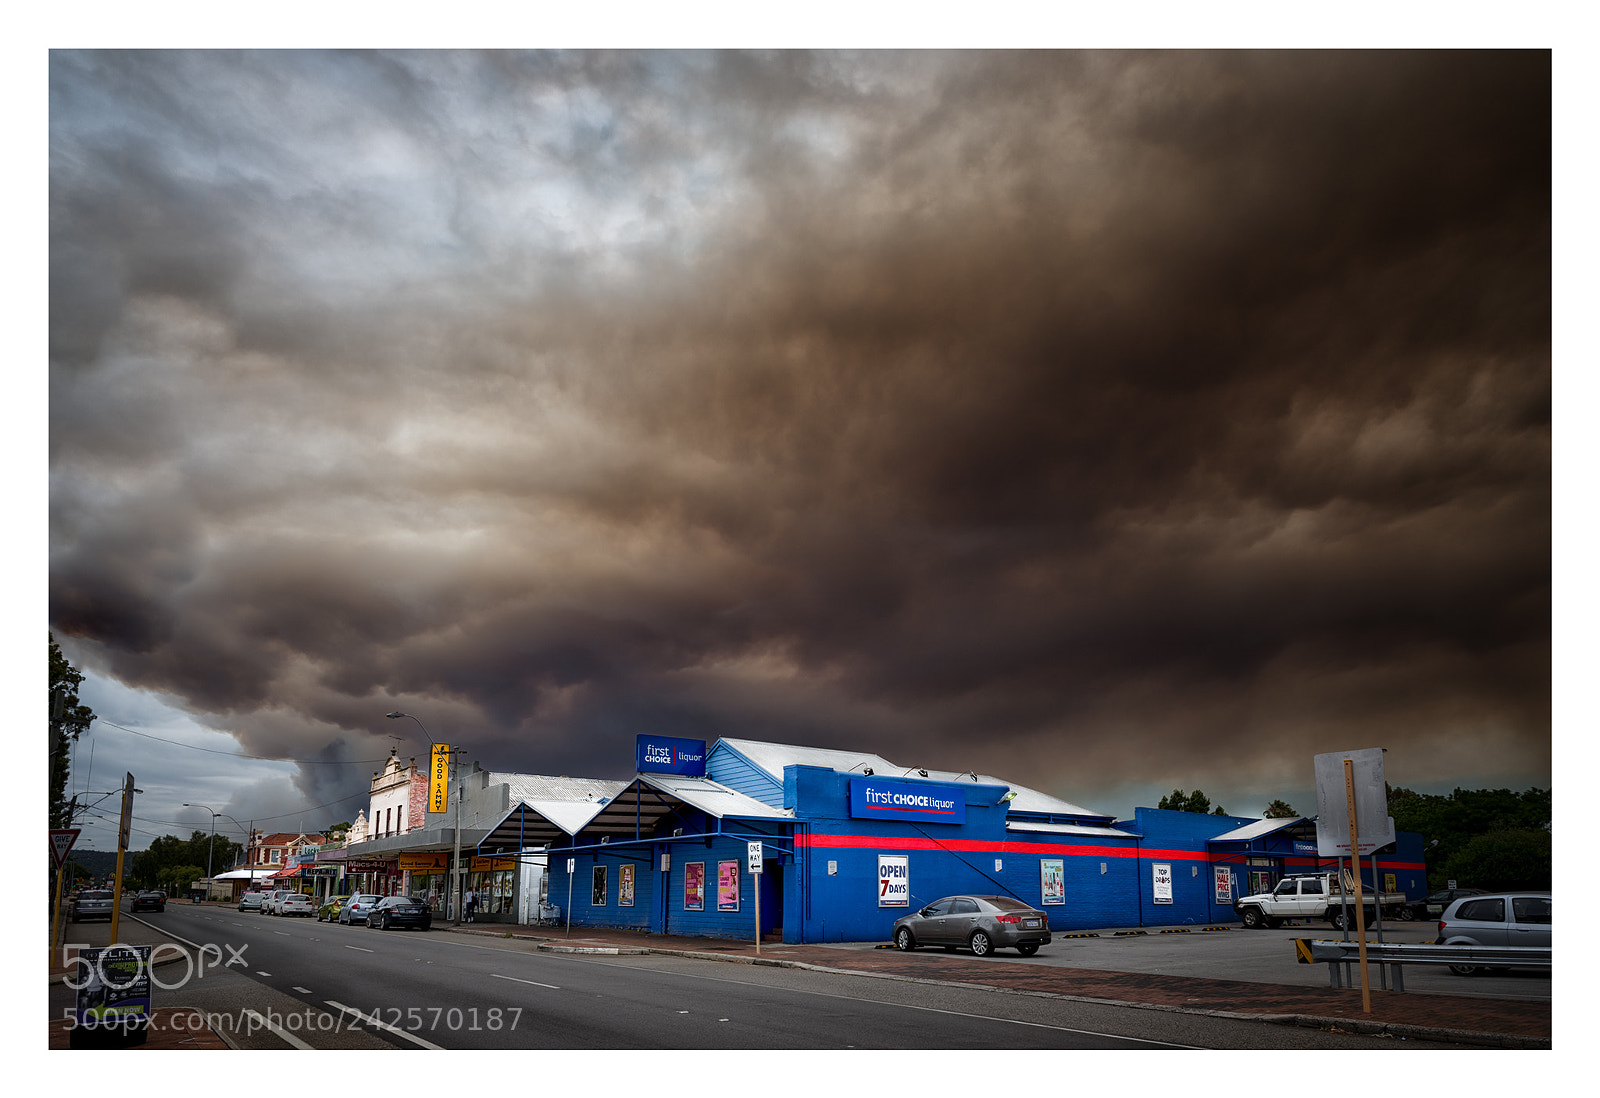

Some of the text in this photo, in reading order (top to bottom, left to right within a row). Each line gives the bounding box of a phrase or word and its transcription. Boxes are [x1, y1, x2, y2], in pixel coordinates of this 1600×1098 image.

[647, 744, 669, 756] first
[645, 755, 671, 764] CHOICE
[678, 752, 702, 762] liquor
[866, 788, 954, 809] first CHOICE liquor
[55, 835, 70, 843] GIVE
[749, 844, 760, 852] ONE
[880, 865, 906, 878] OPEN
[1217, 874, 1229, 883] HALF
[880, 880, 906, 896] 7 DAYS
[98, 950, 142, 958] ELITE
